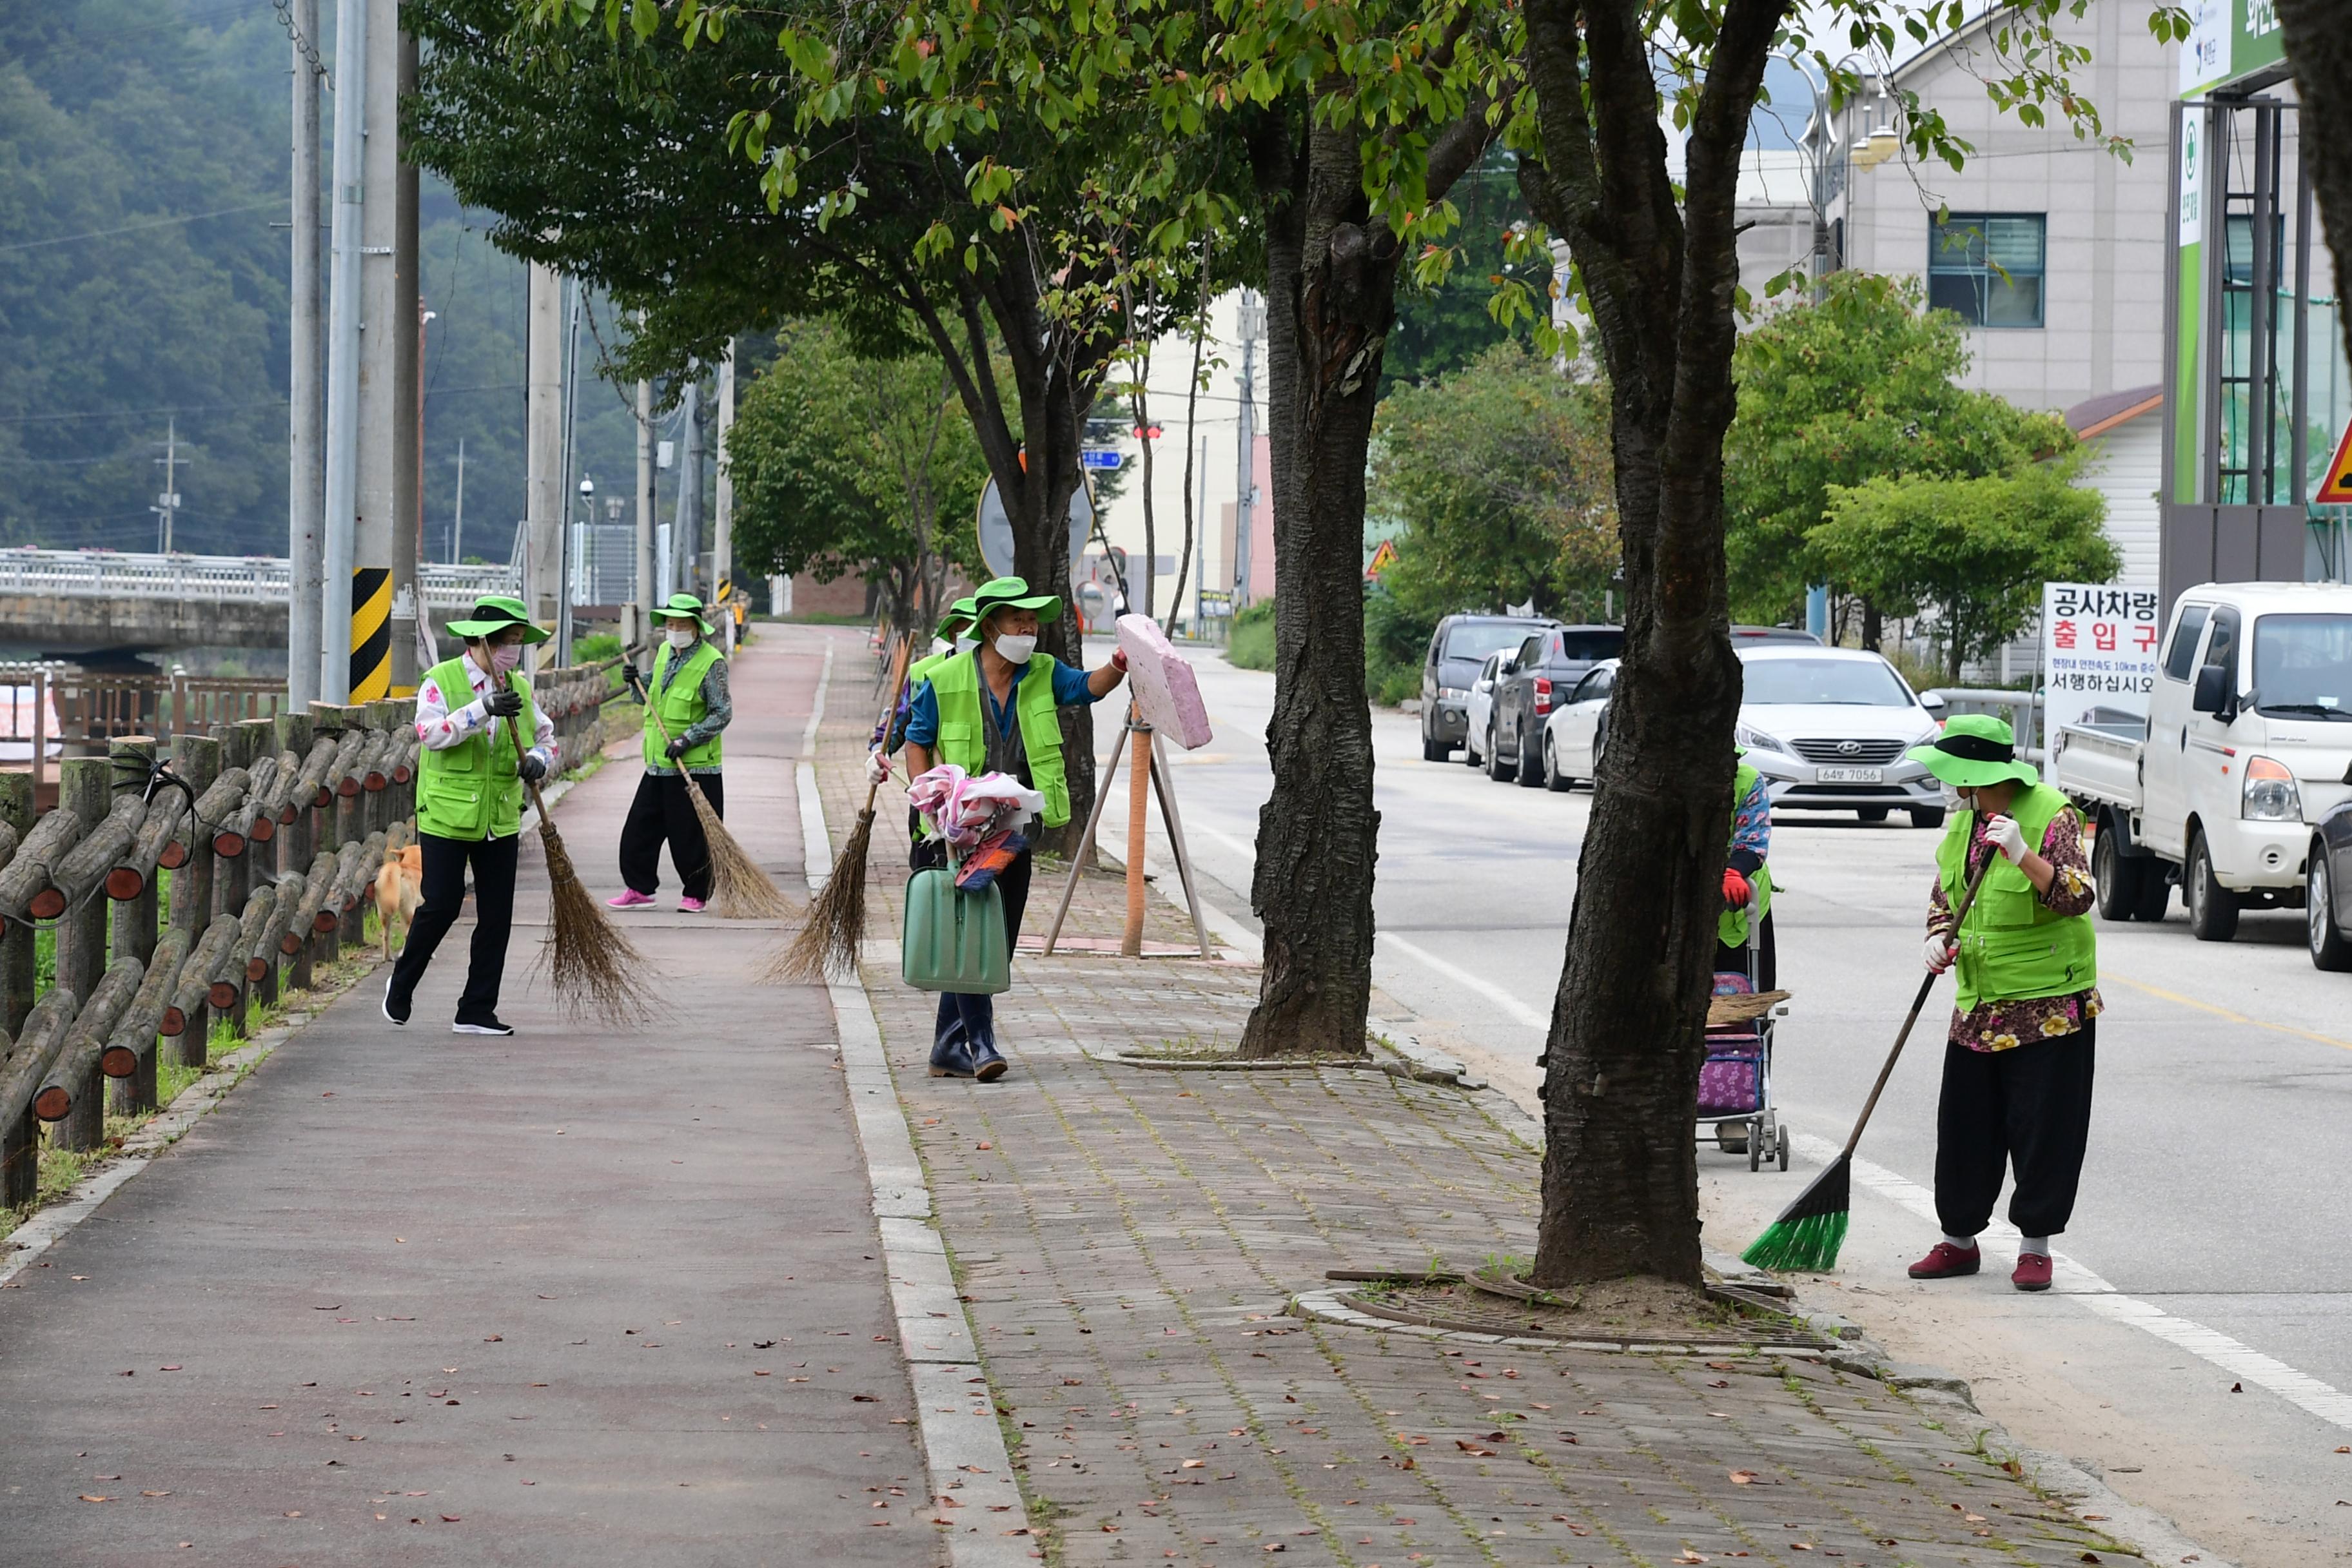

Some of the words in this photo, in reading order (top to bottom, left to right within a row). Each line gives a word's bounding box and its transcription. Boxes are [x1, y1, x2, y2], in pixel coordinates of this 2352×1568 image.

[2054, 589, 2157, 621] 공사차량
[2053, 658, 2076, 670] 현장내
[2079, 660, 2112, 671] 안전속도
[2115, 662, 2137, 672] 10km
[2141, 663, 2156, 674] 준수
[2052, 673, 2154, 694] 서행하십시오
[1849, 770, 1876, 780] 7056
